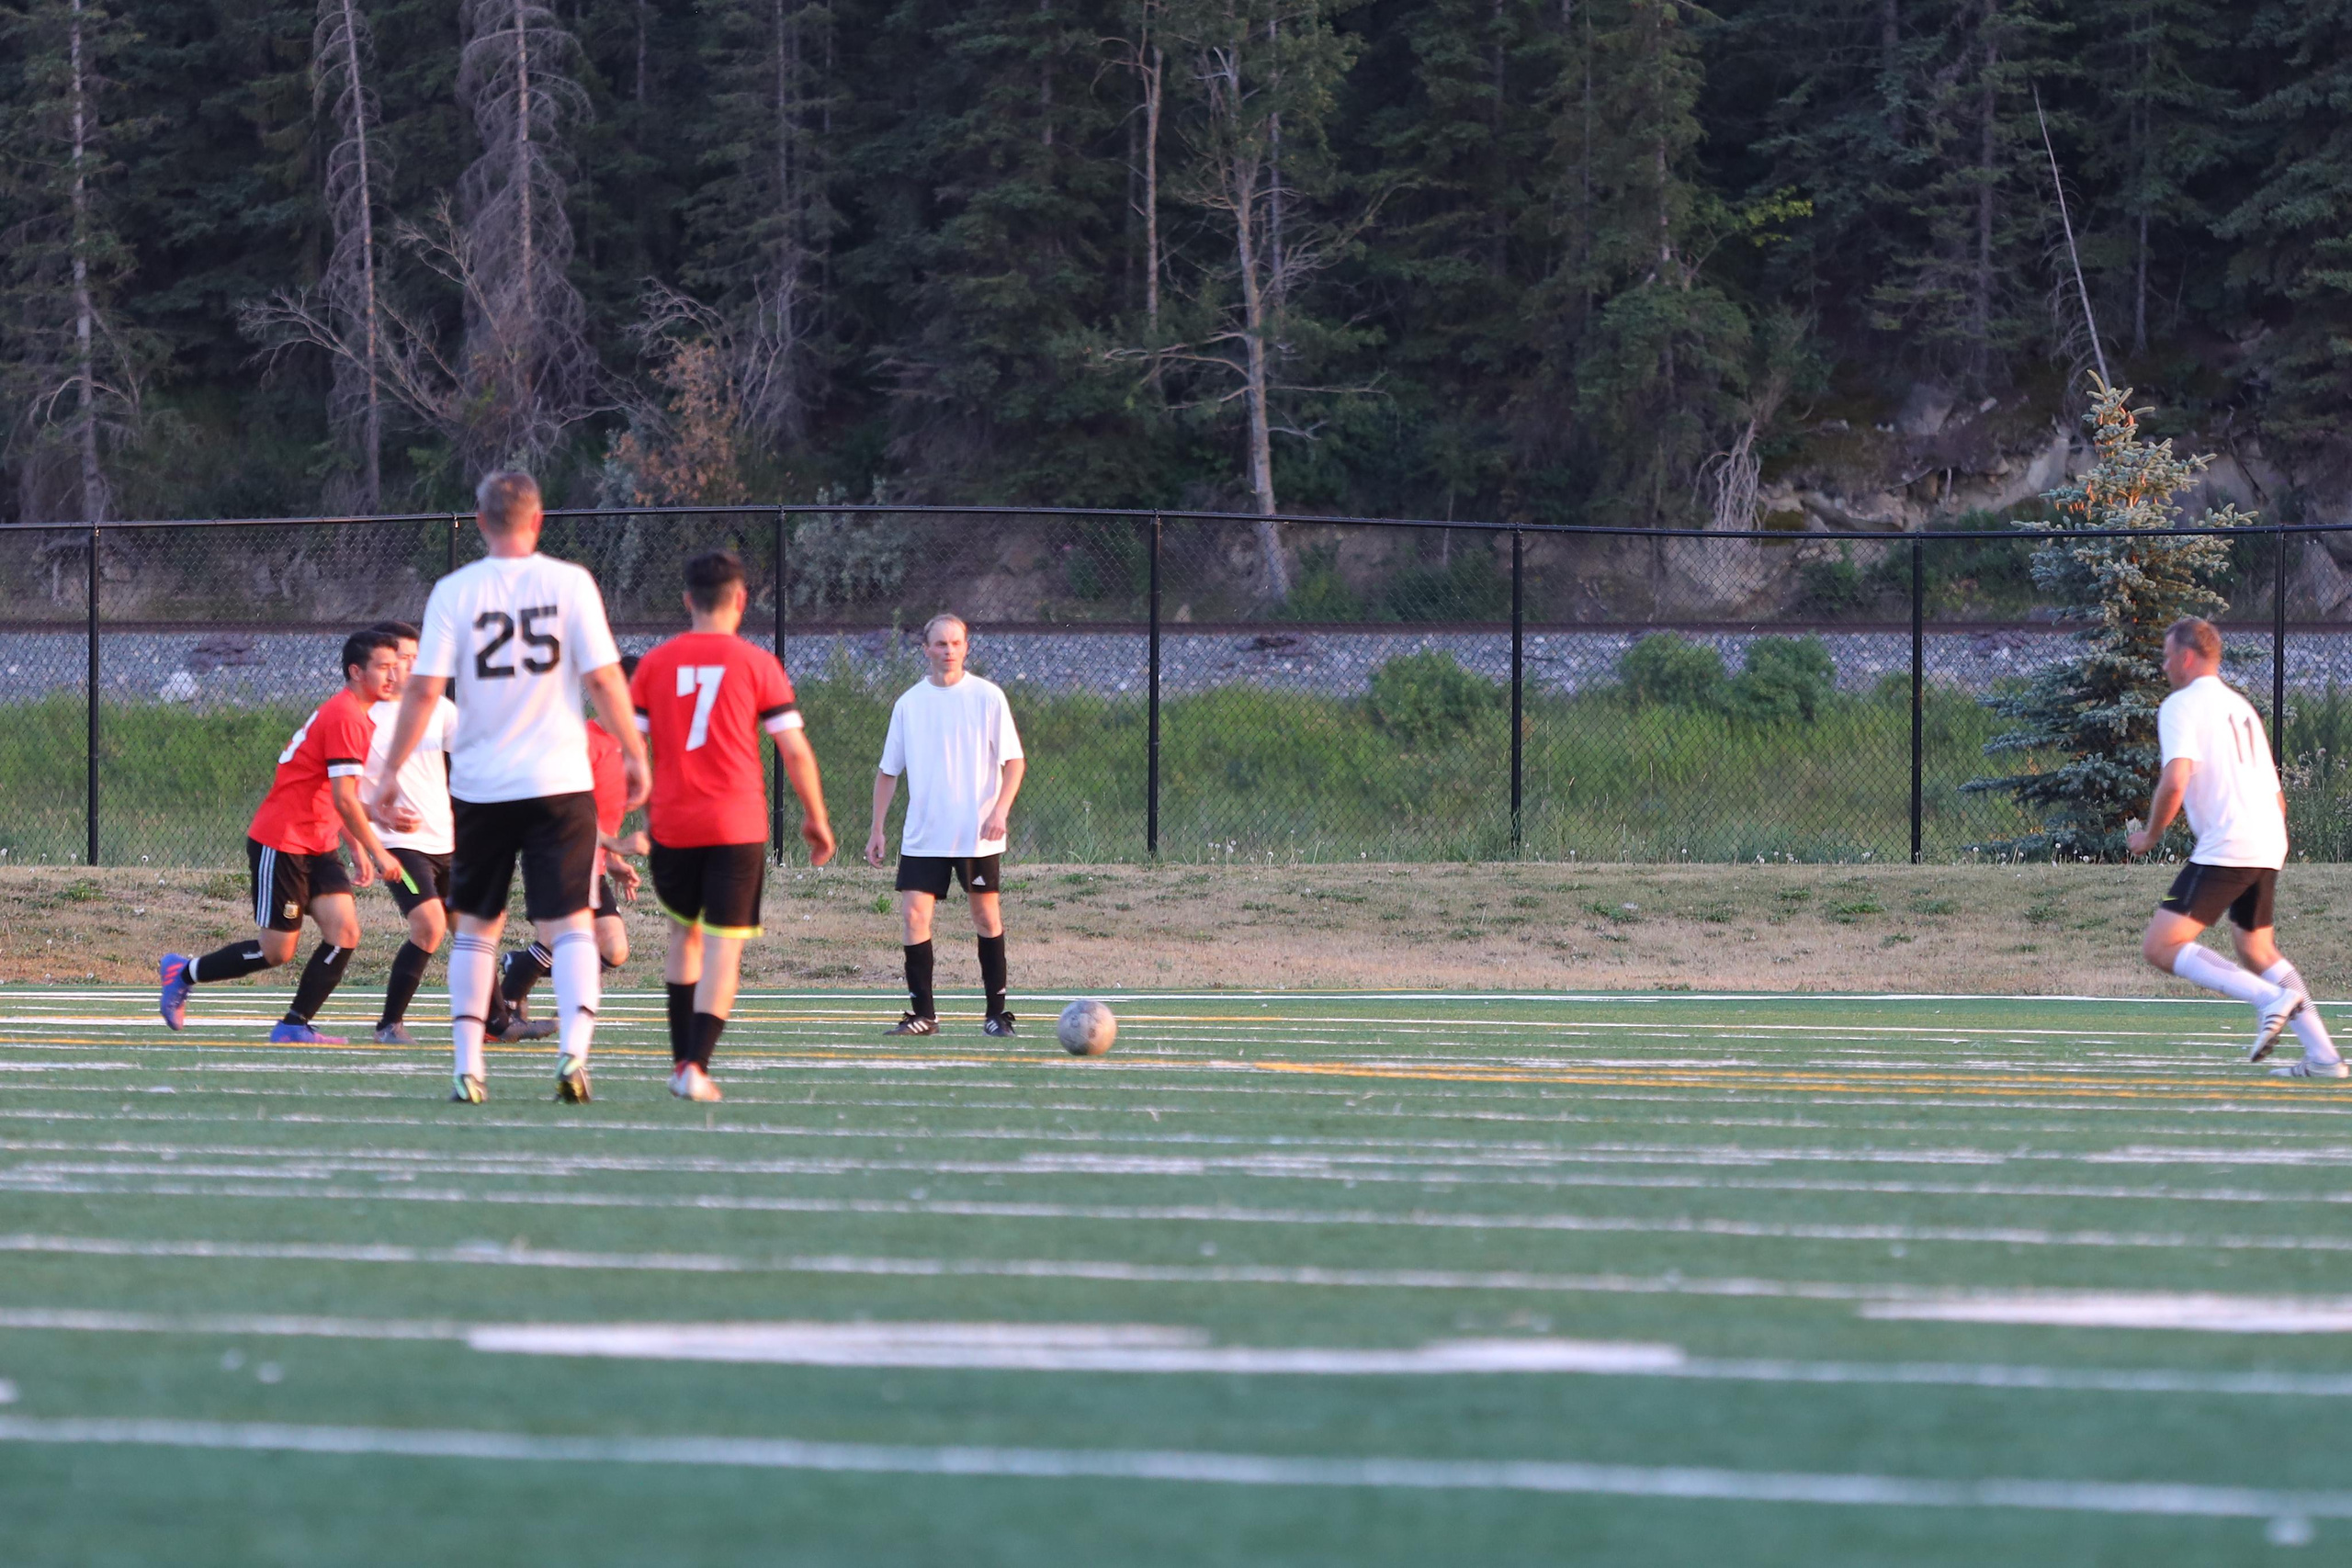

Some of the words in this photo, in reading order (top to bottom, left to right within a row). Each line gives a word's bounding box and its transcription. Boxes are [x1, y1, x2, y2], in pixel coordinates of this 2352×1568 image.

[473, 605, 560, 680] 25
[676, 665, 726, 751] 7
[2227, 713, 2257, 768] 11
